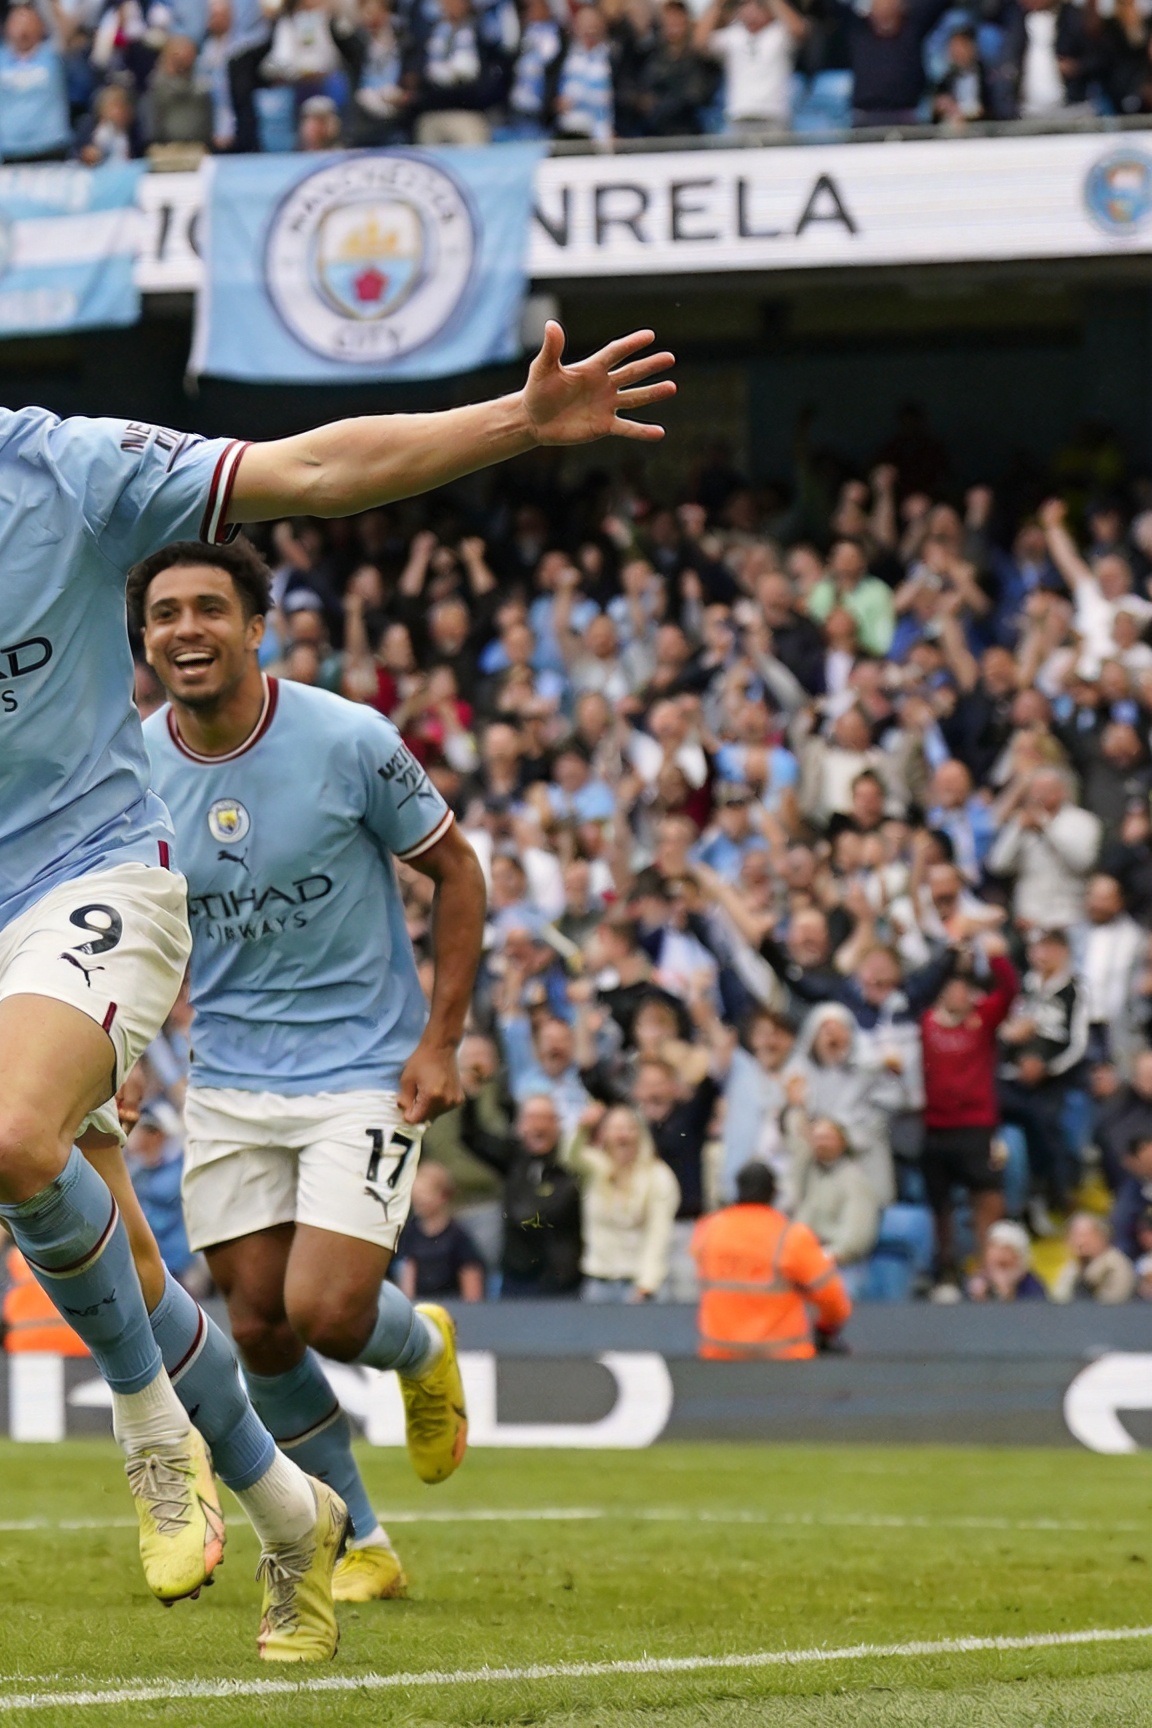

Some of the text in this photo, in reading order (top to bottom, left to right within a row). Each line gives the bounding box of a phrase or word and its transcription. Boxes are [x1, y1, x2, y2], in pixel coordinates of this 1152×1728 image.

[189, 874, 333, 920] TIHAD
[69, 903, 123, 955] 9
[365, 1128, 414, 1190] 17
